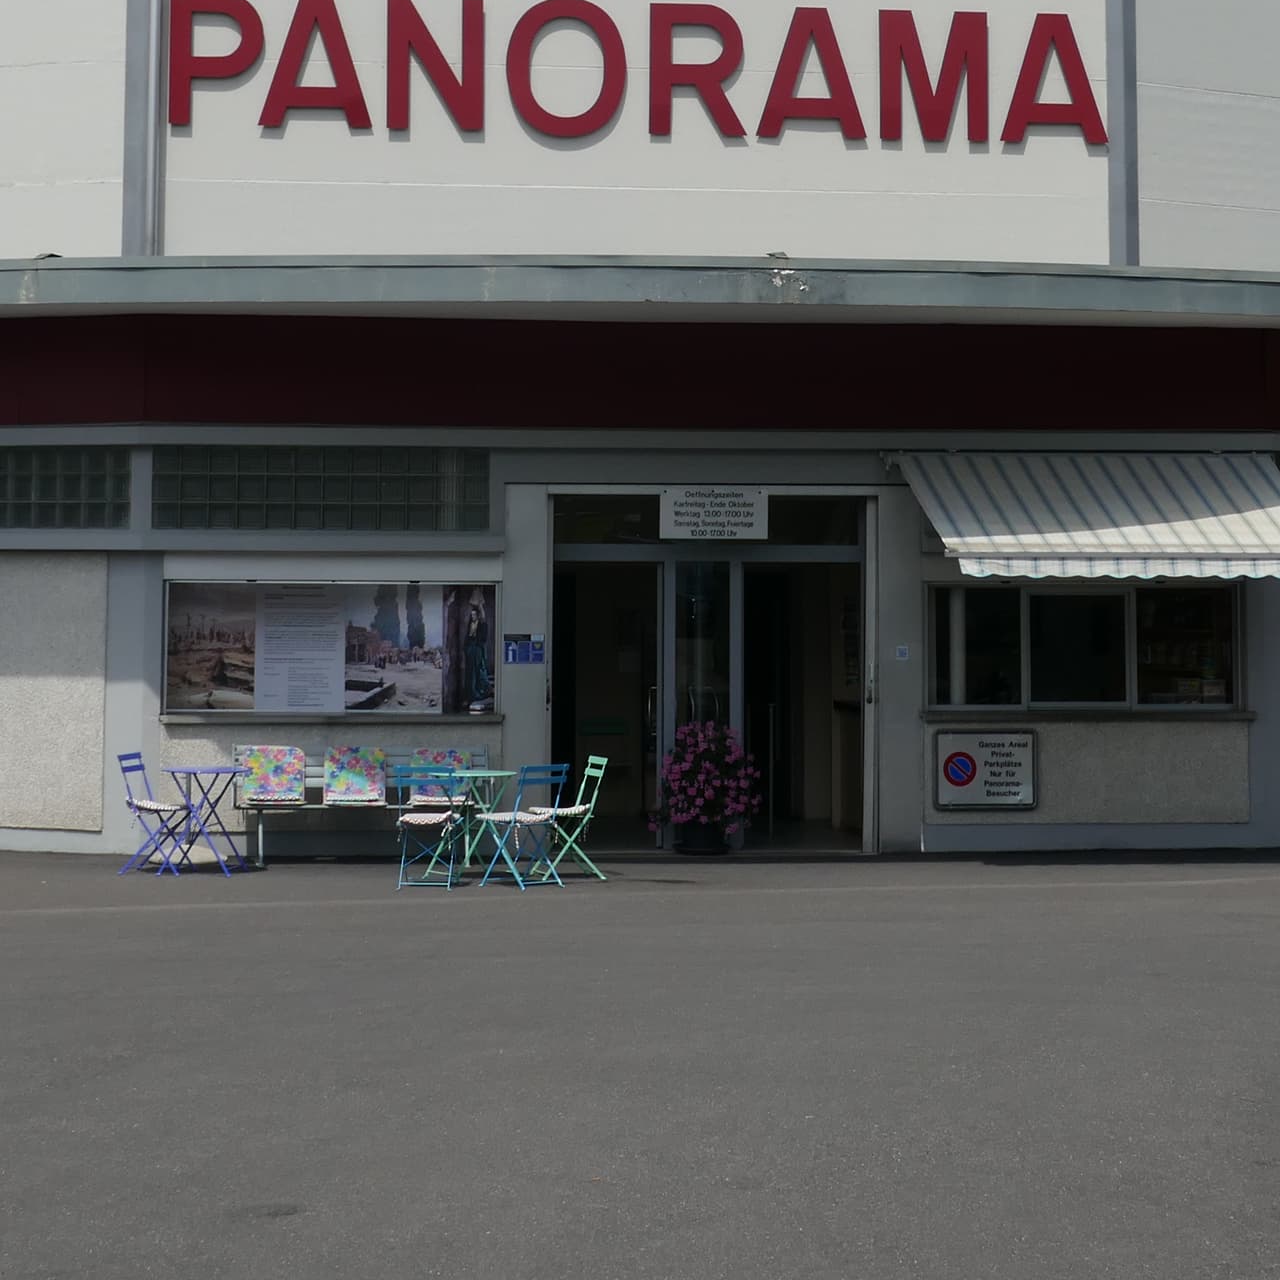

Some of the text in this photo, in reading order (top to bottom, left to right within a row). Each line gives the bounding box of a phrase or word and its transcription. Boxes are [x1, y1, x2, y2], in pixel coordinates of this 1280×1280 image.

[710, 500, 726, 508] Ende
[728, 500, 754, 508] Oktober
[743, 510, 754, 518] Uhr
[727, 529, 737, 537] Uhr
[991, 750, 1015, 758] Privat-
[984, 760, 1022, 768] Parkplätze
[986, 789, 1021, 797] Besucher
